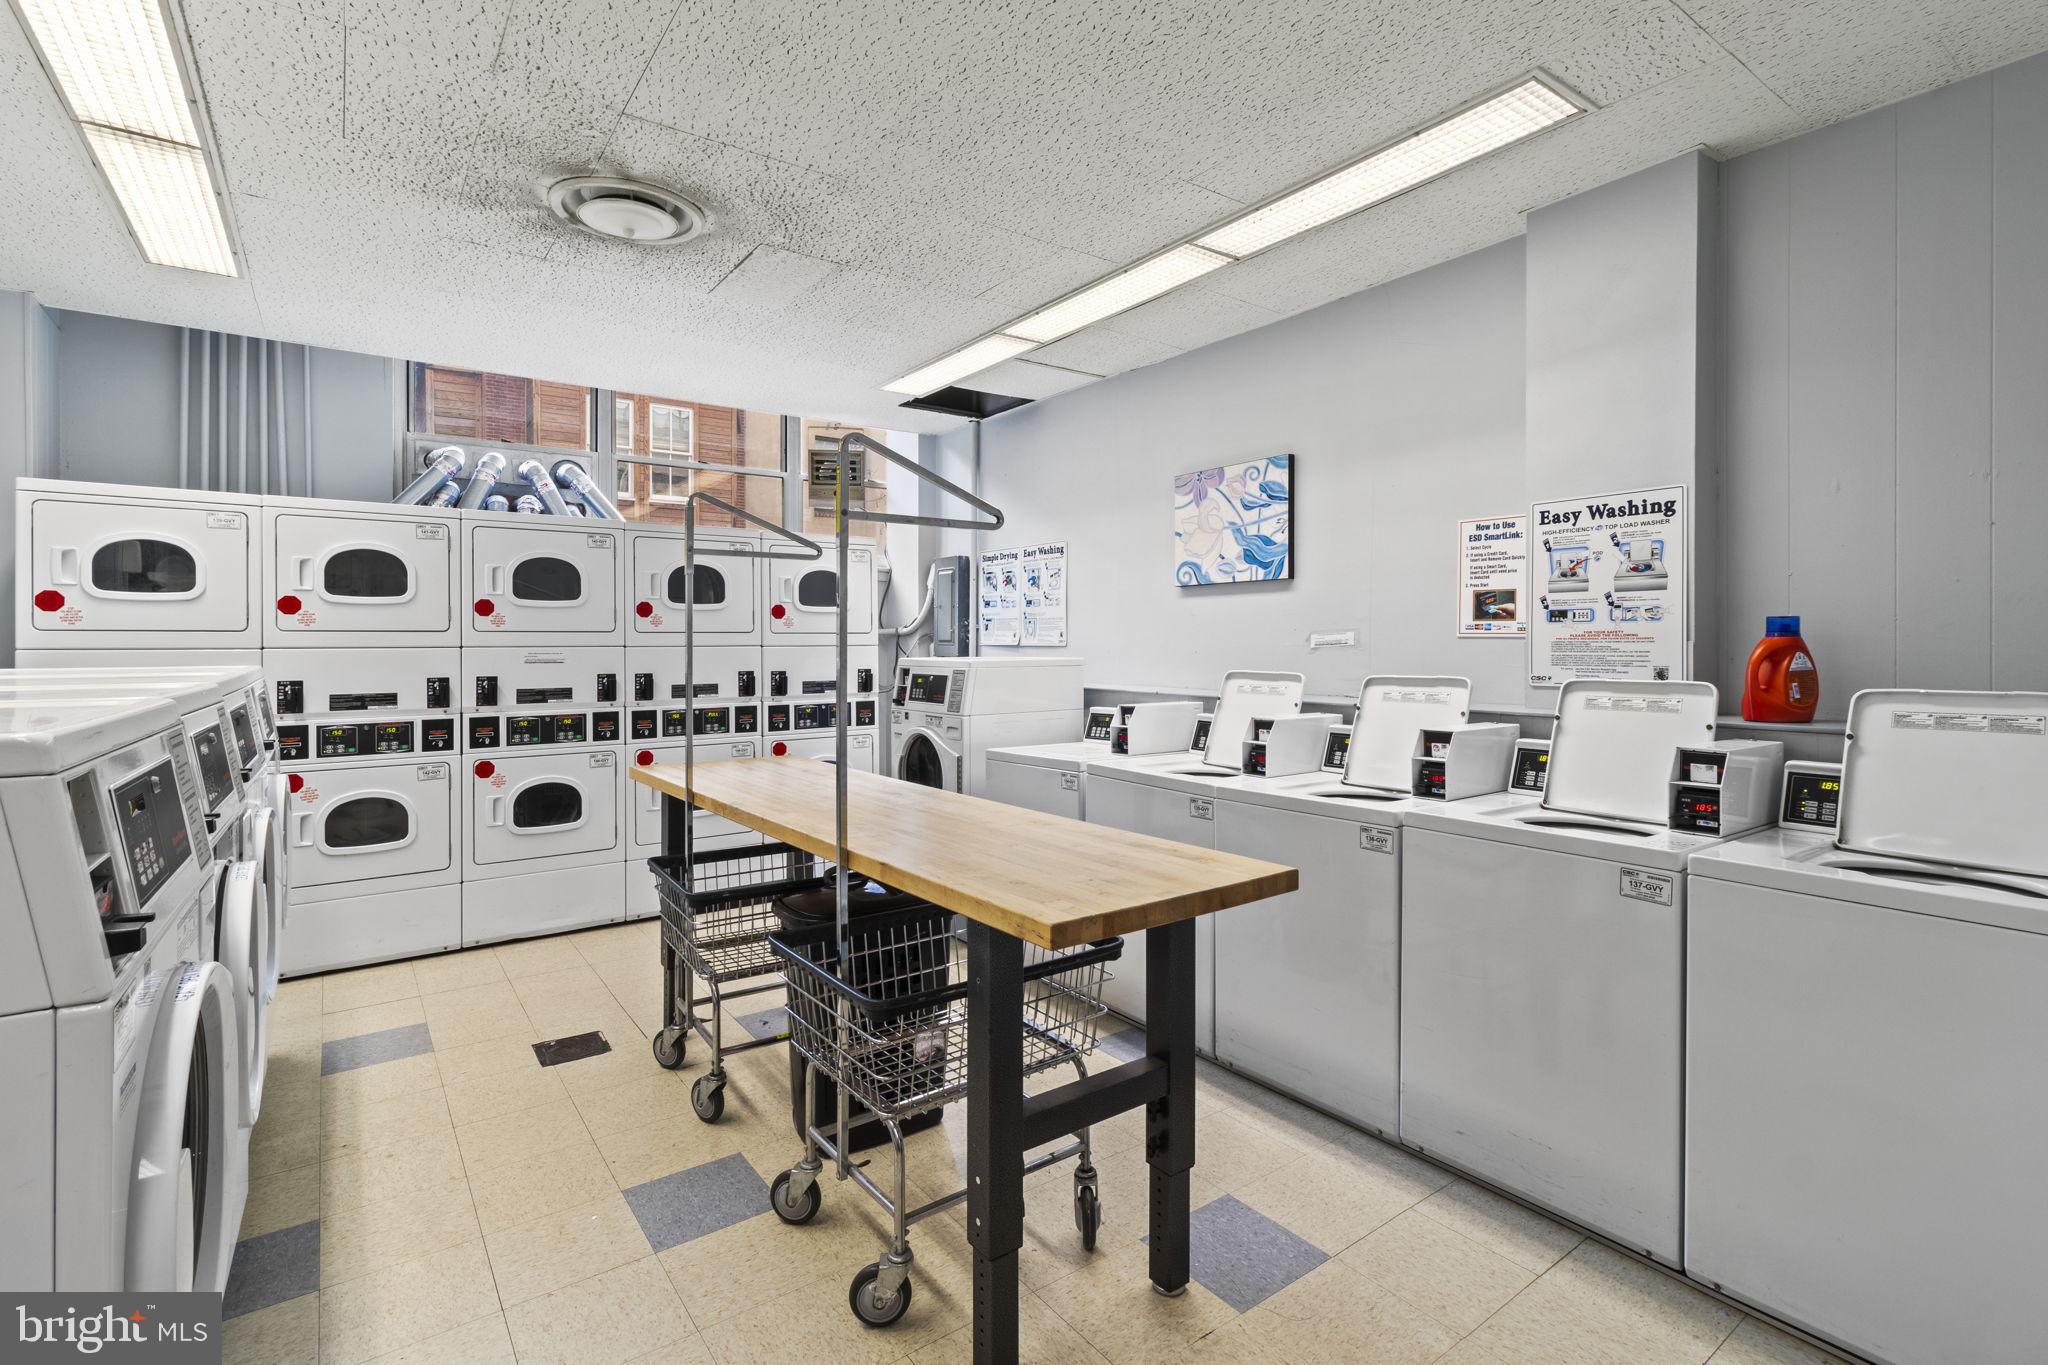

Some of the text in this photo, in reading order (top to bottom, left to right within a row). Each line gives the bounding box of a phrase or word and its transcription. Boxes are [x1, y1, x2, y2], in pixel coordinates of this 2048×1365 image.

[1539, 499, 1677, 526] Easy Washing
[1475, 521, 1516, 531] How to Use
[1619, 521, 1639, 529] LOAD
[1640, 518, 1671, 527] WASHER
[1542, 525, 1595, 536] HIGH-EFFICIENCY
[1469, 531, 1523, 542] ESD SmartLink:
[982, 554, 999, 563] Simple
[1000, 552, 1019, 561] Drying
[1023, 545, 1065, 559] Easy Washing
[1629, 880, 1664, 893] 137-GVY
